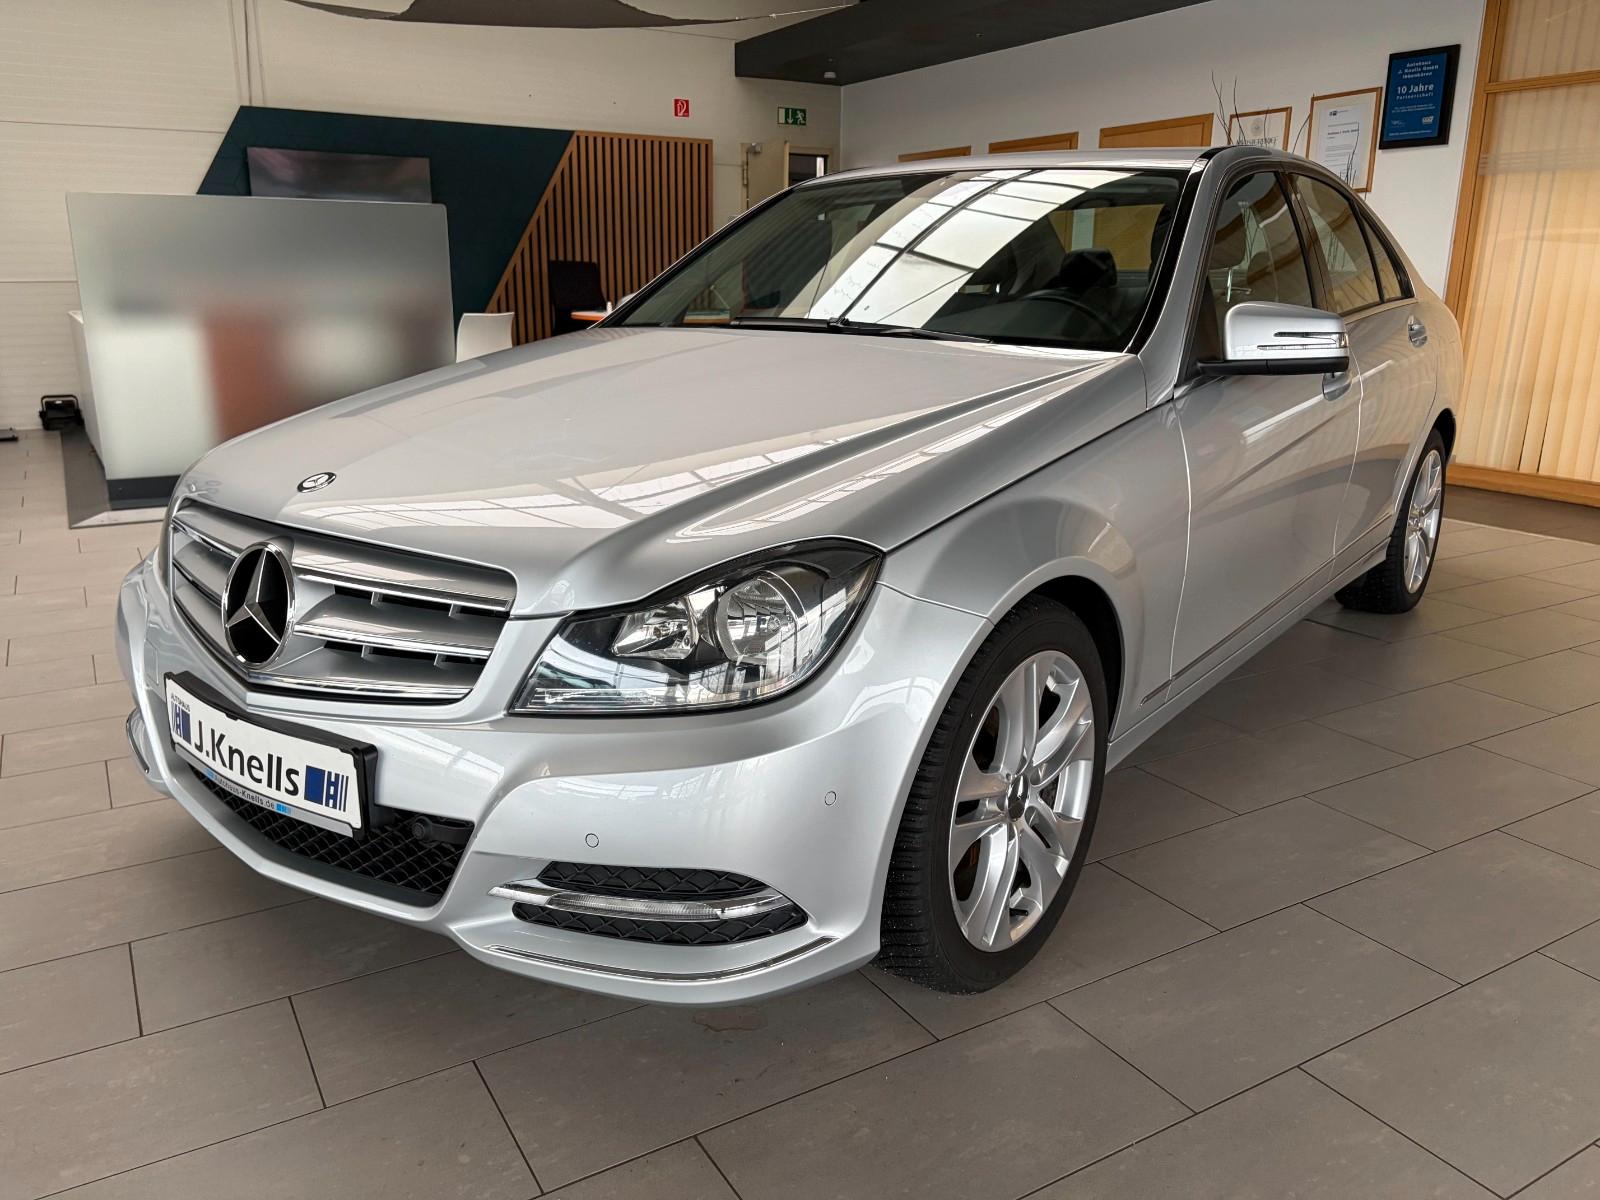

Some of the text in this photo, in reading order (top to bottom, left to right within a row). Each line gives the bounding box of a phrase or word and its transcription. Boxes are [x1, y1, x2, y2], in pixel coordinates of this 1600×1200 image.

[1397, 83, 1434, 95] 10 Jahre
[1396, 92, 1434, 100] Partnerschaft
[194, 719, 300, 797] J.Knells
